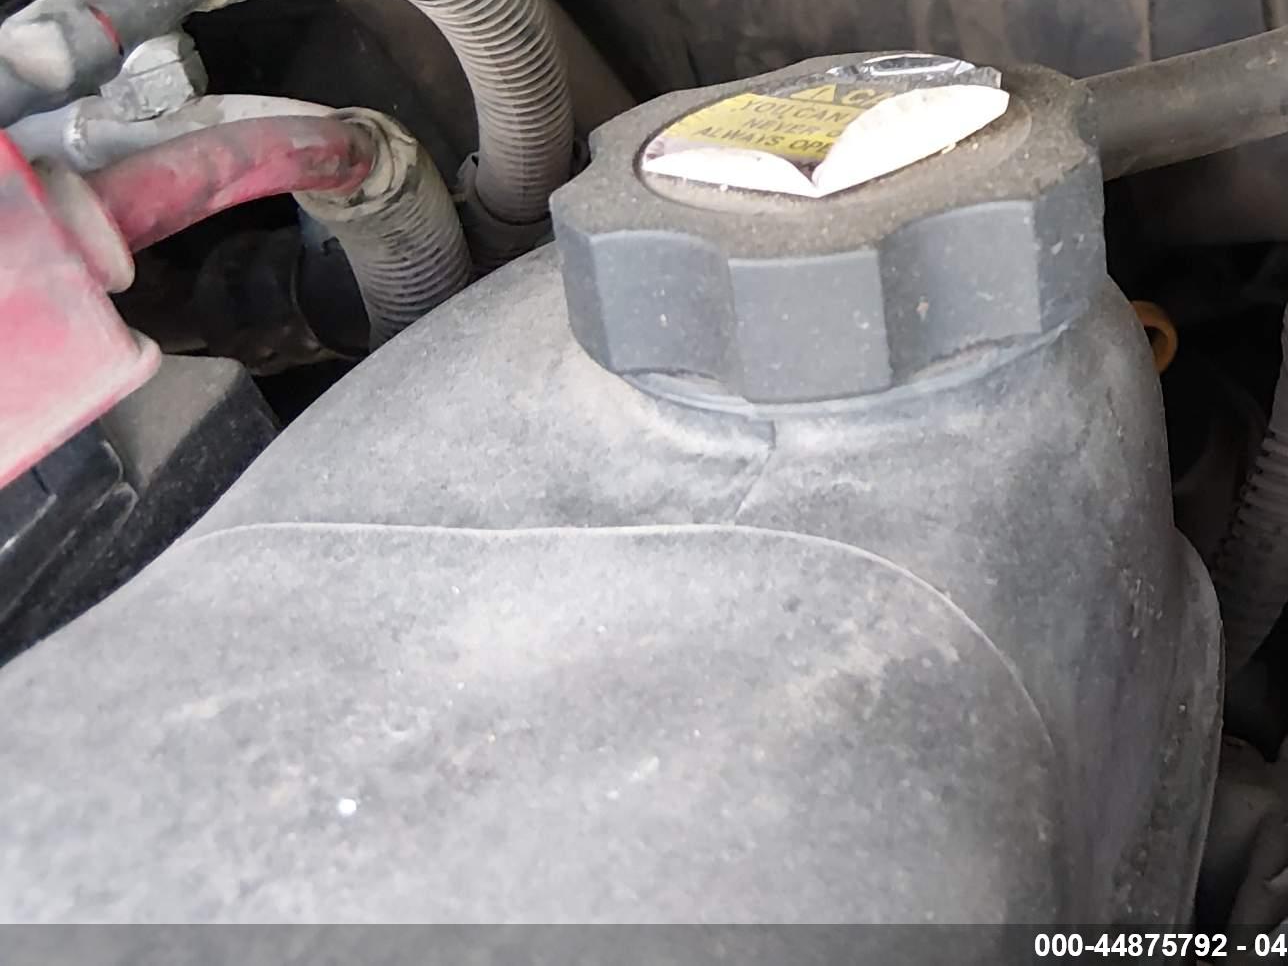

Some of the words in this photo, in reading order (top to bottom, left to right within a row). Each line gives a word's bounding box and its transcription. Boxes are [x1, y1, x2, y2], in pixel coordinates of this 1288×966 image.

[740, 100, 794, 115] YOU
[793, 107, 850, 123] CAN
[742, 118, 821, 136] NEVER
[699, 126, 786, 147] ALWAYS
[788, 139, 834, 154] OPE
